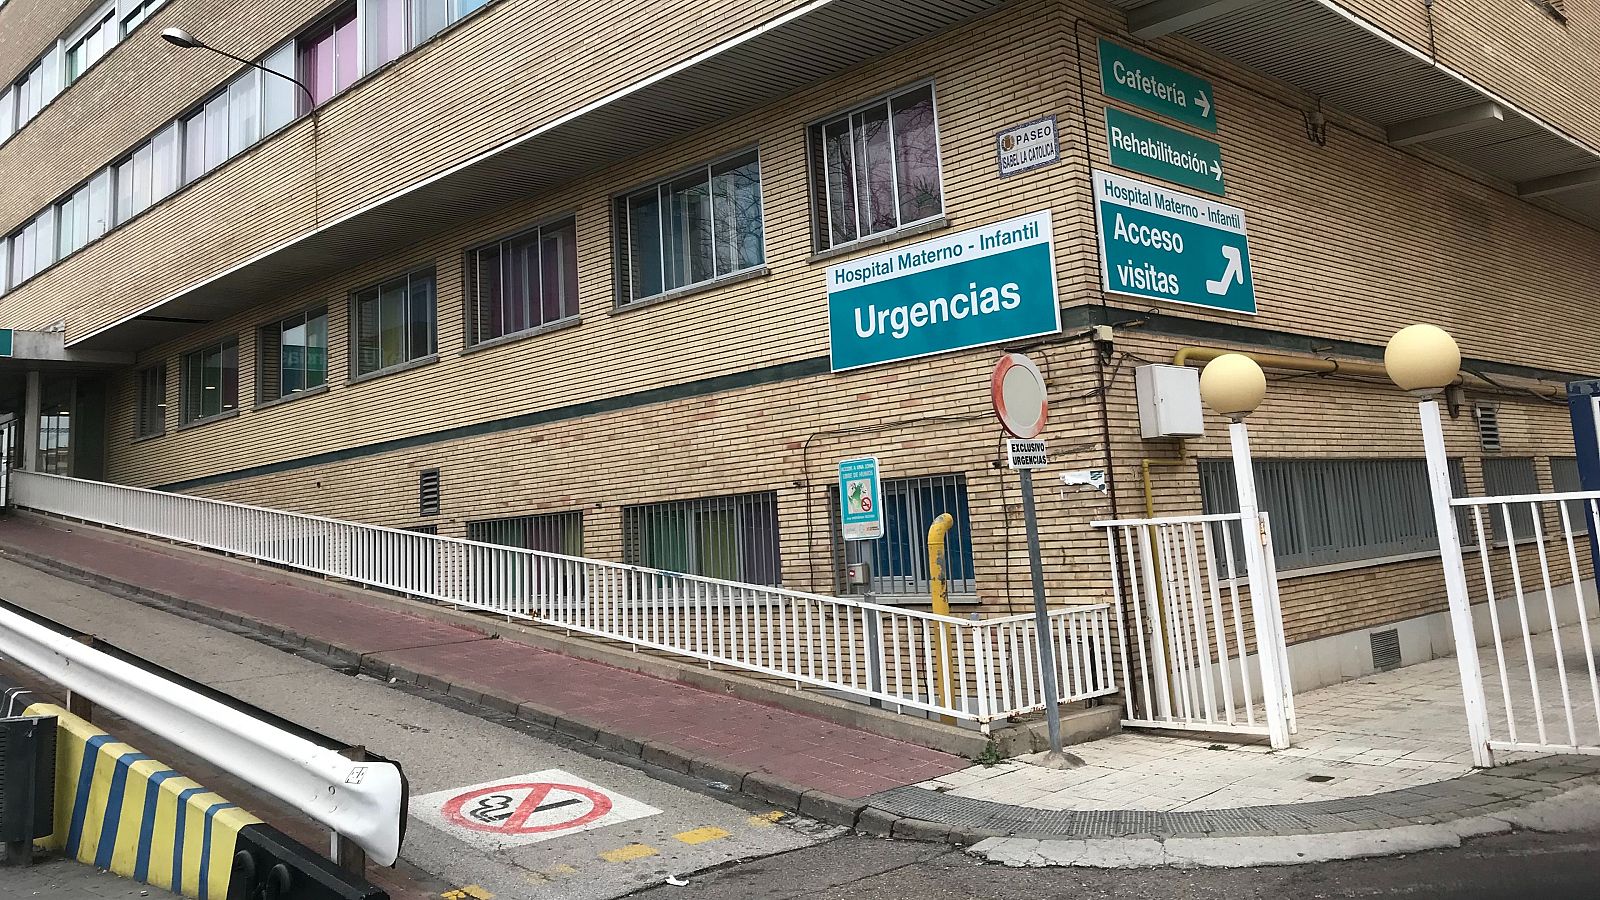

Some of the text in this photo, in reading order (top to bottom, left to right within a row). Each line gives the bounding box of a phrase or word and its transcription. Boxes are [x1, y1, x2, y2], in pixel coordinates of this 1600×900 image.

[1113, 60, 1186, 107] Cafetería
[1016, 126, 1051, 145] PASEO
[1111, 126, 1208, 175] Rehabilitación
[1002, 153, 1020, 170] ISABEL
[1020, 151, 1028, 164] LA
[1104, 179, 1152, 206] Hospital
[1154, 192, 1199, 218] Materno
[1207, 207, 1241, 229] Infantil
[835, 258, 894, 285] Hospital
[898, 243, 963, 271] Materno
[980, 221, 1039, 251] Infantil
[1113, 212, 1184, 254] Acceso
[1116, 259, 1180, 295] visitas
[854, 281, 1021, 339] Urgencias
[1011, 442, 1045, 452] EXCLUSIVO
[1012, 455, 1047, 466] URGENCIAS
